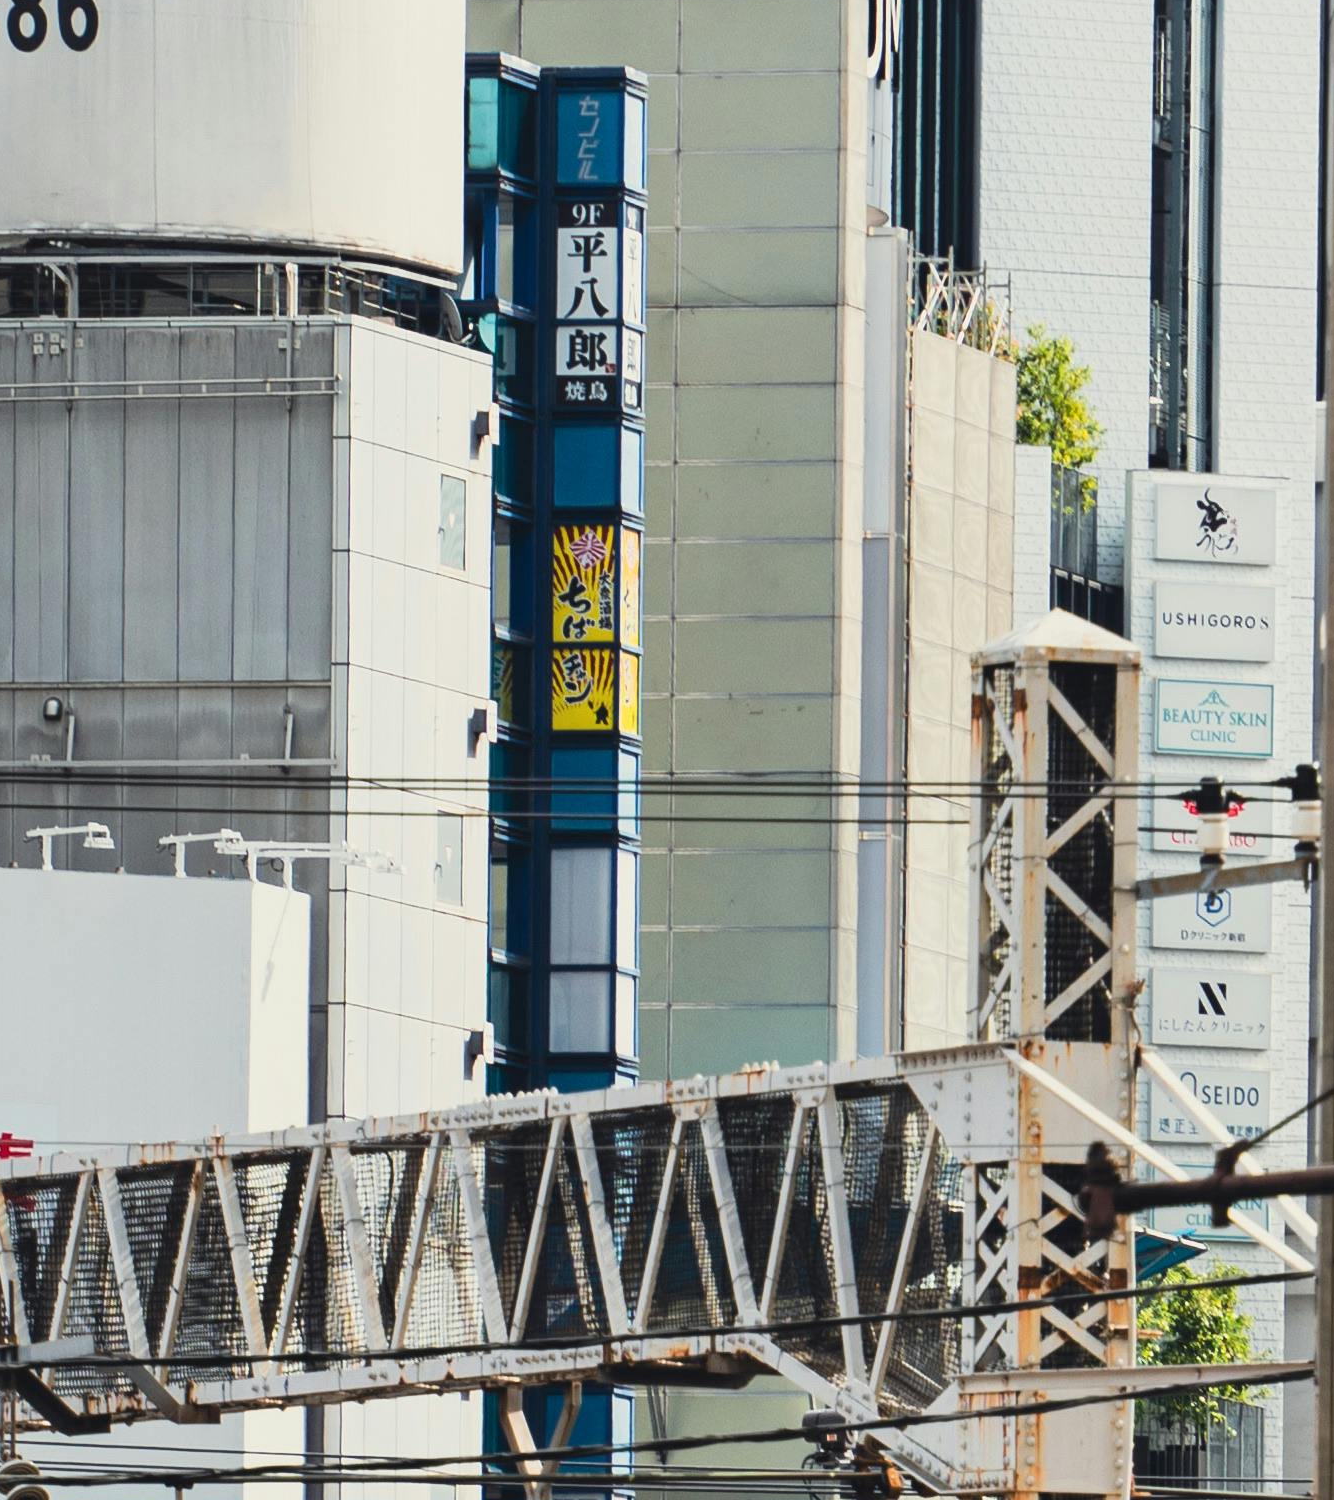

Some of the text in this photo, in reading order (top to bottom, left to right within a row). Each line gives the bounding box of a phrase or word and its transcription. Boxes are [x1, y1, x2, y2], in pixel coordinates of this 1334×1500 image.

[572, 203, 605, 227] 9F
[564, 231, 609, 372] 平八郎
[565, 381, 608, 402] 焼鳥
[1162, 612, 1256, 629] USHIGORO
[1163, 708, 1267, 727] BEAUTY SKIN
[1190, 729, 1236, 743] CLINIC
[1158, 1019, 1266, 1036] にしたんクリニック
